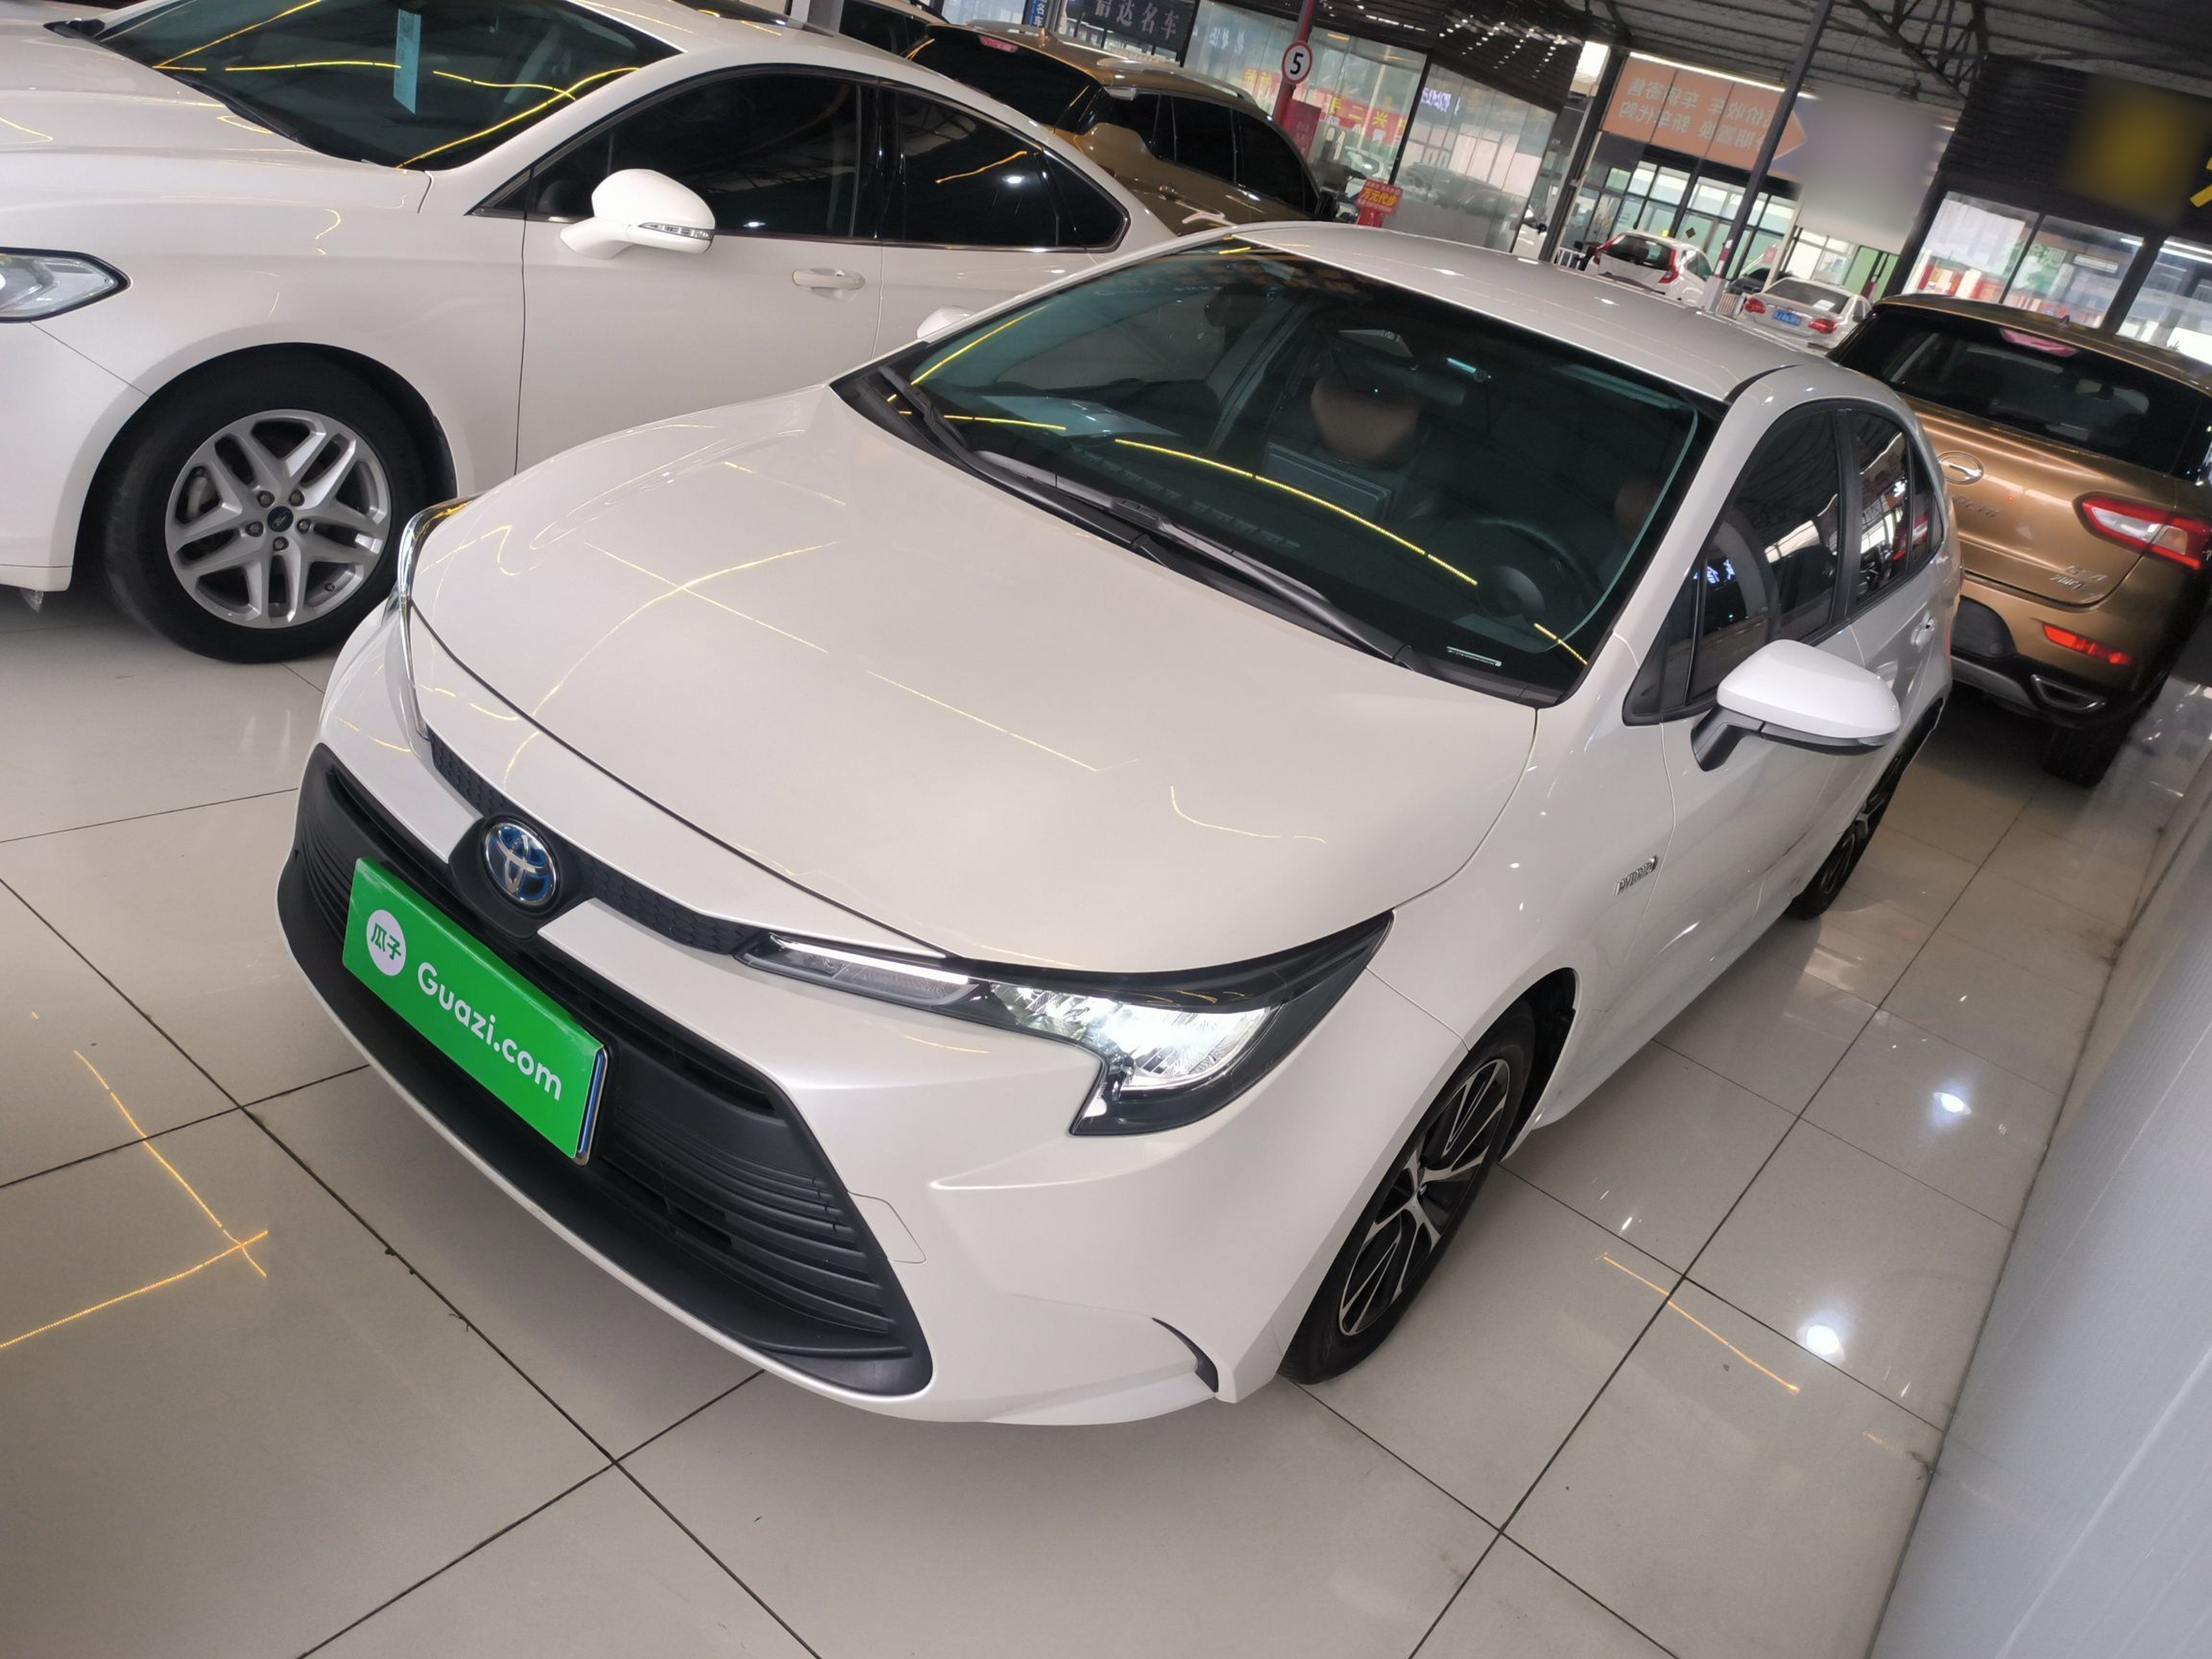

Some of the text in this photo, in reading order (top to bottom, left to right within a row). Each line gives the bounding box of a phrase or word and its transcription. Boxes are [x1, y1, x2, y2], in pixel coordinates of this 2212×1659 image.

[1290, 52, 1304, 75] 5
[370, 922, 402, 961] 瓜子
[417, 961, 562, 1101] Guazi.com
